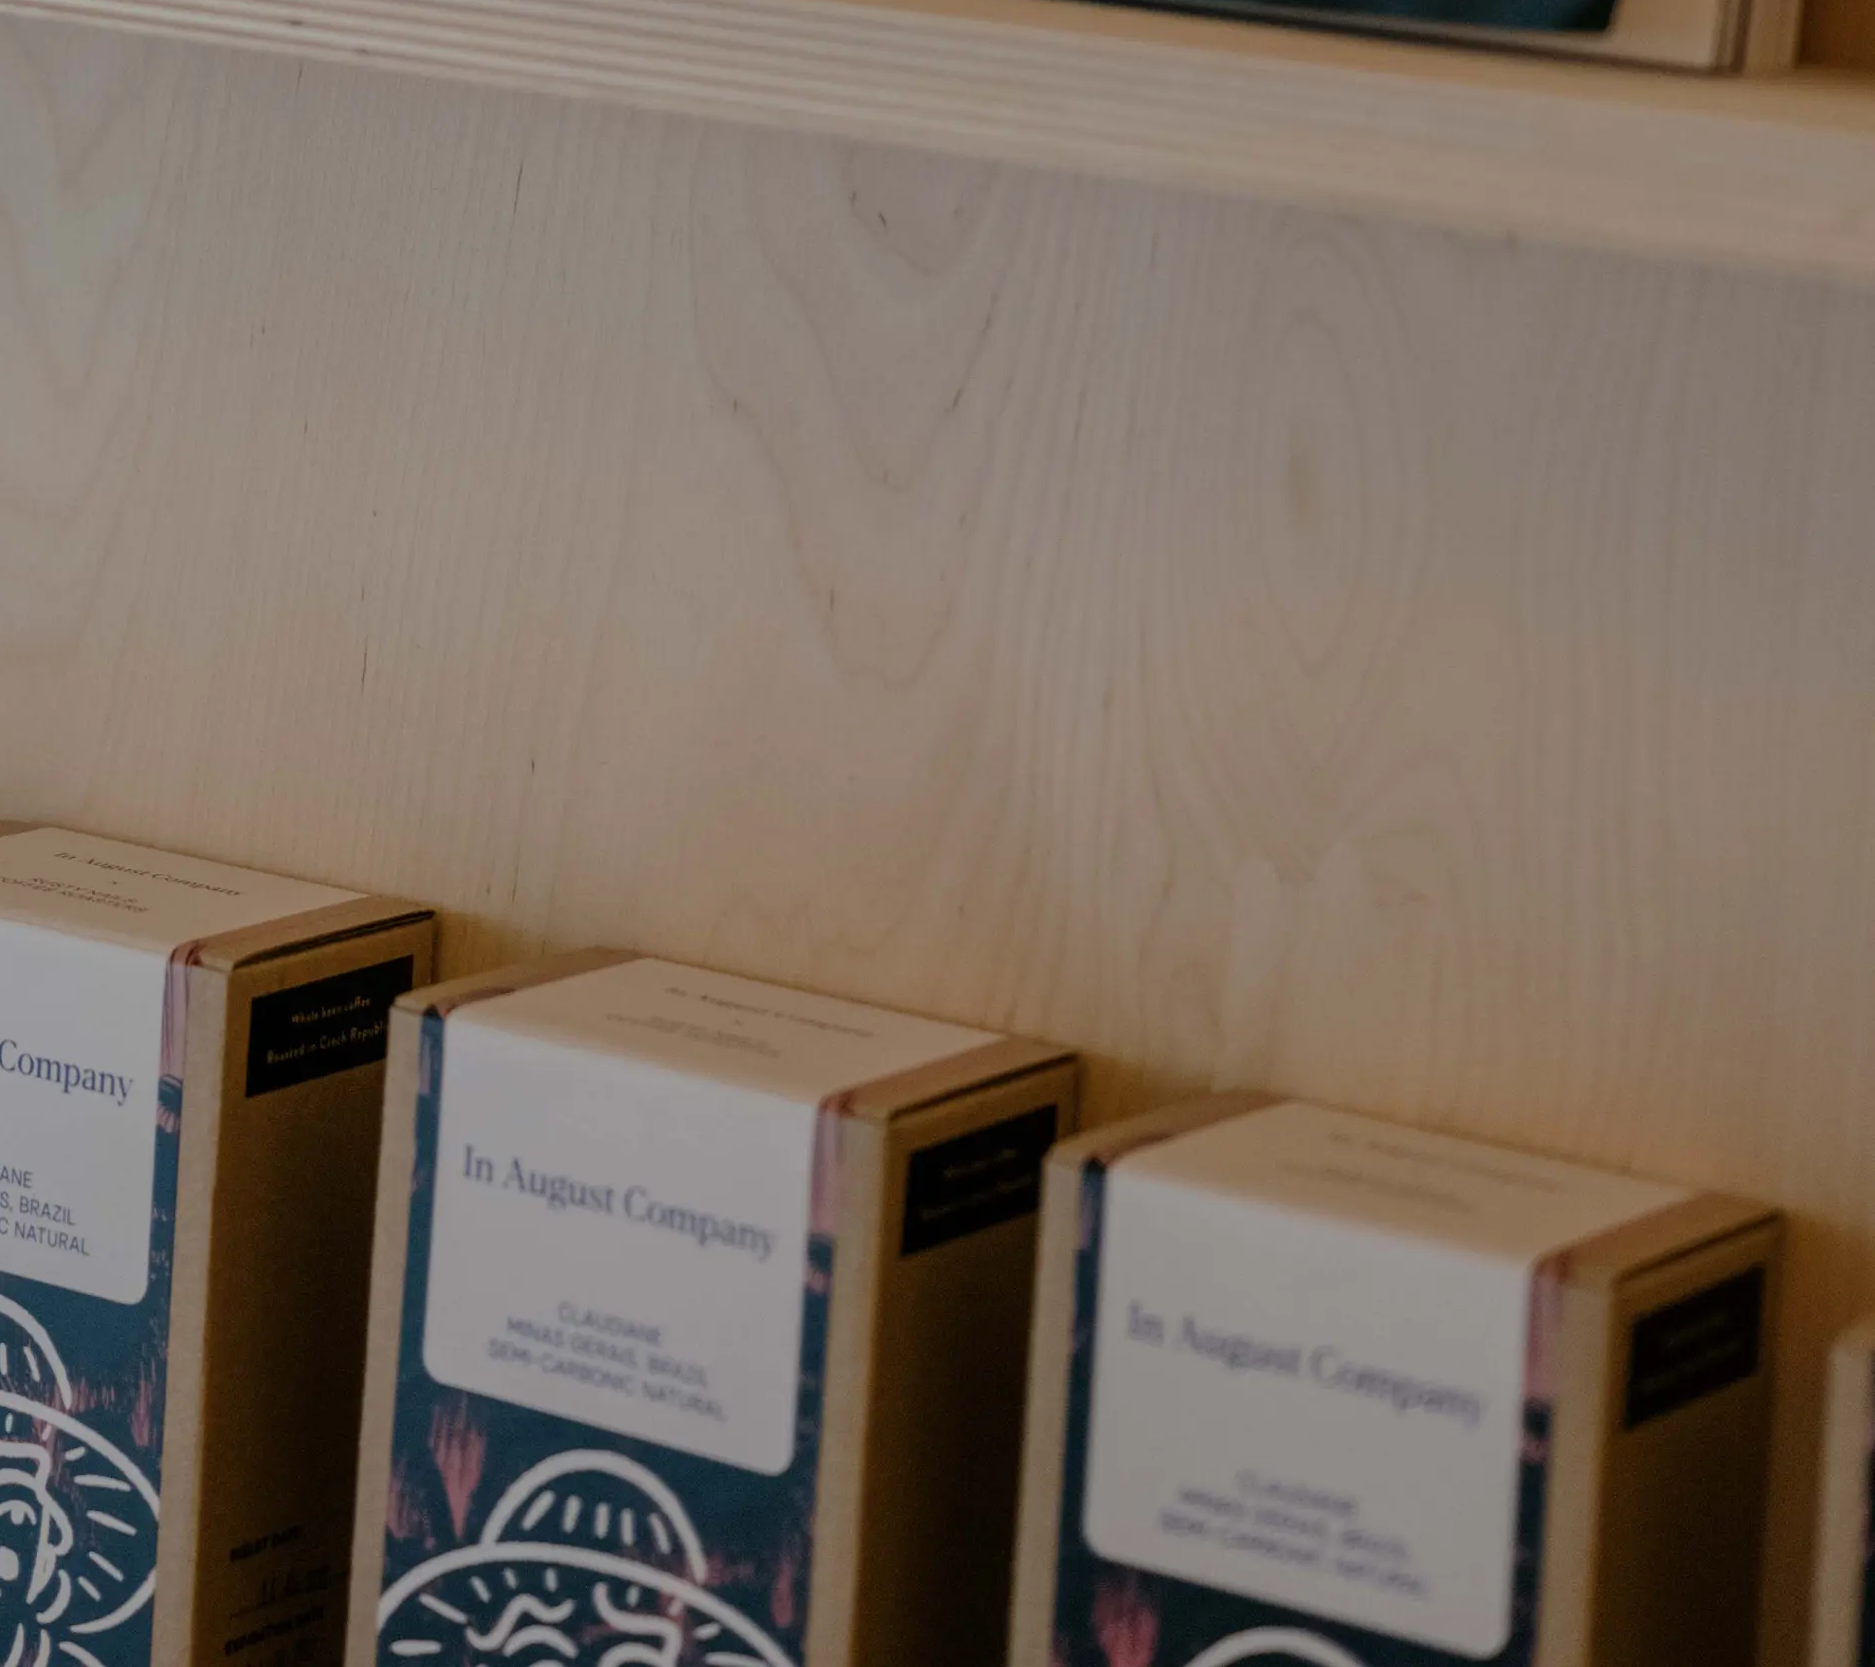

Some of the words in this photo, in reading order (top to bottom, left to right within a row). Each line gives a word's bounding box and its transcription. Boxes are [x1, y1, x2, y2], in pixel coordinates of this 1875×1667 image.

[18, 1196, 76, 1228] BRAZIL
[462, 1143, 495, 1184] In
[502, 1156, 616, 1216] August
[623, 1184, 781, 1264] Company
[13, 1220, 91, 1257] NATURAL
